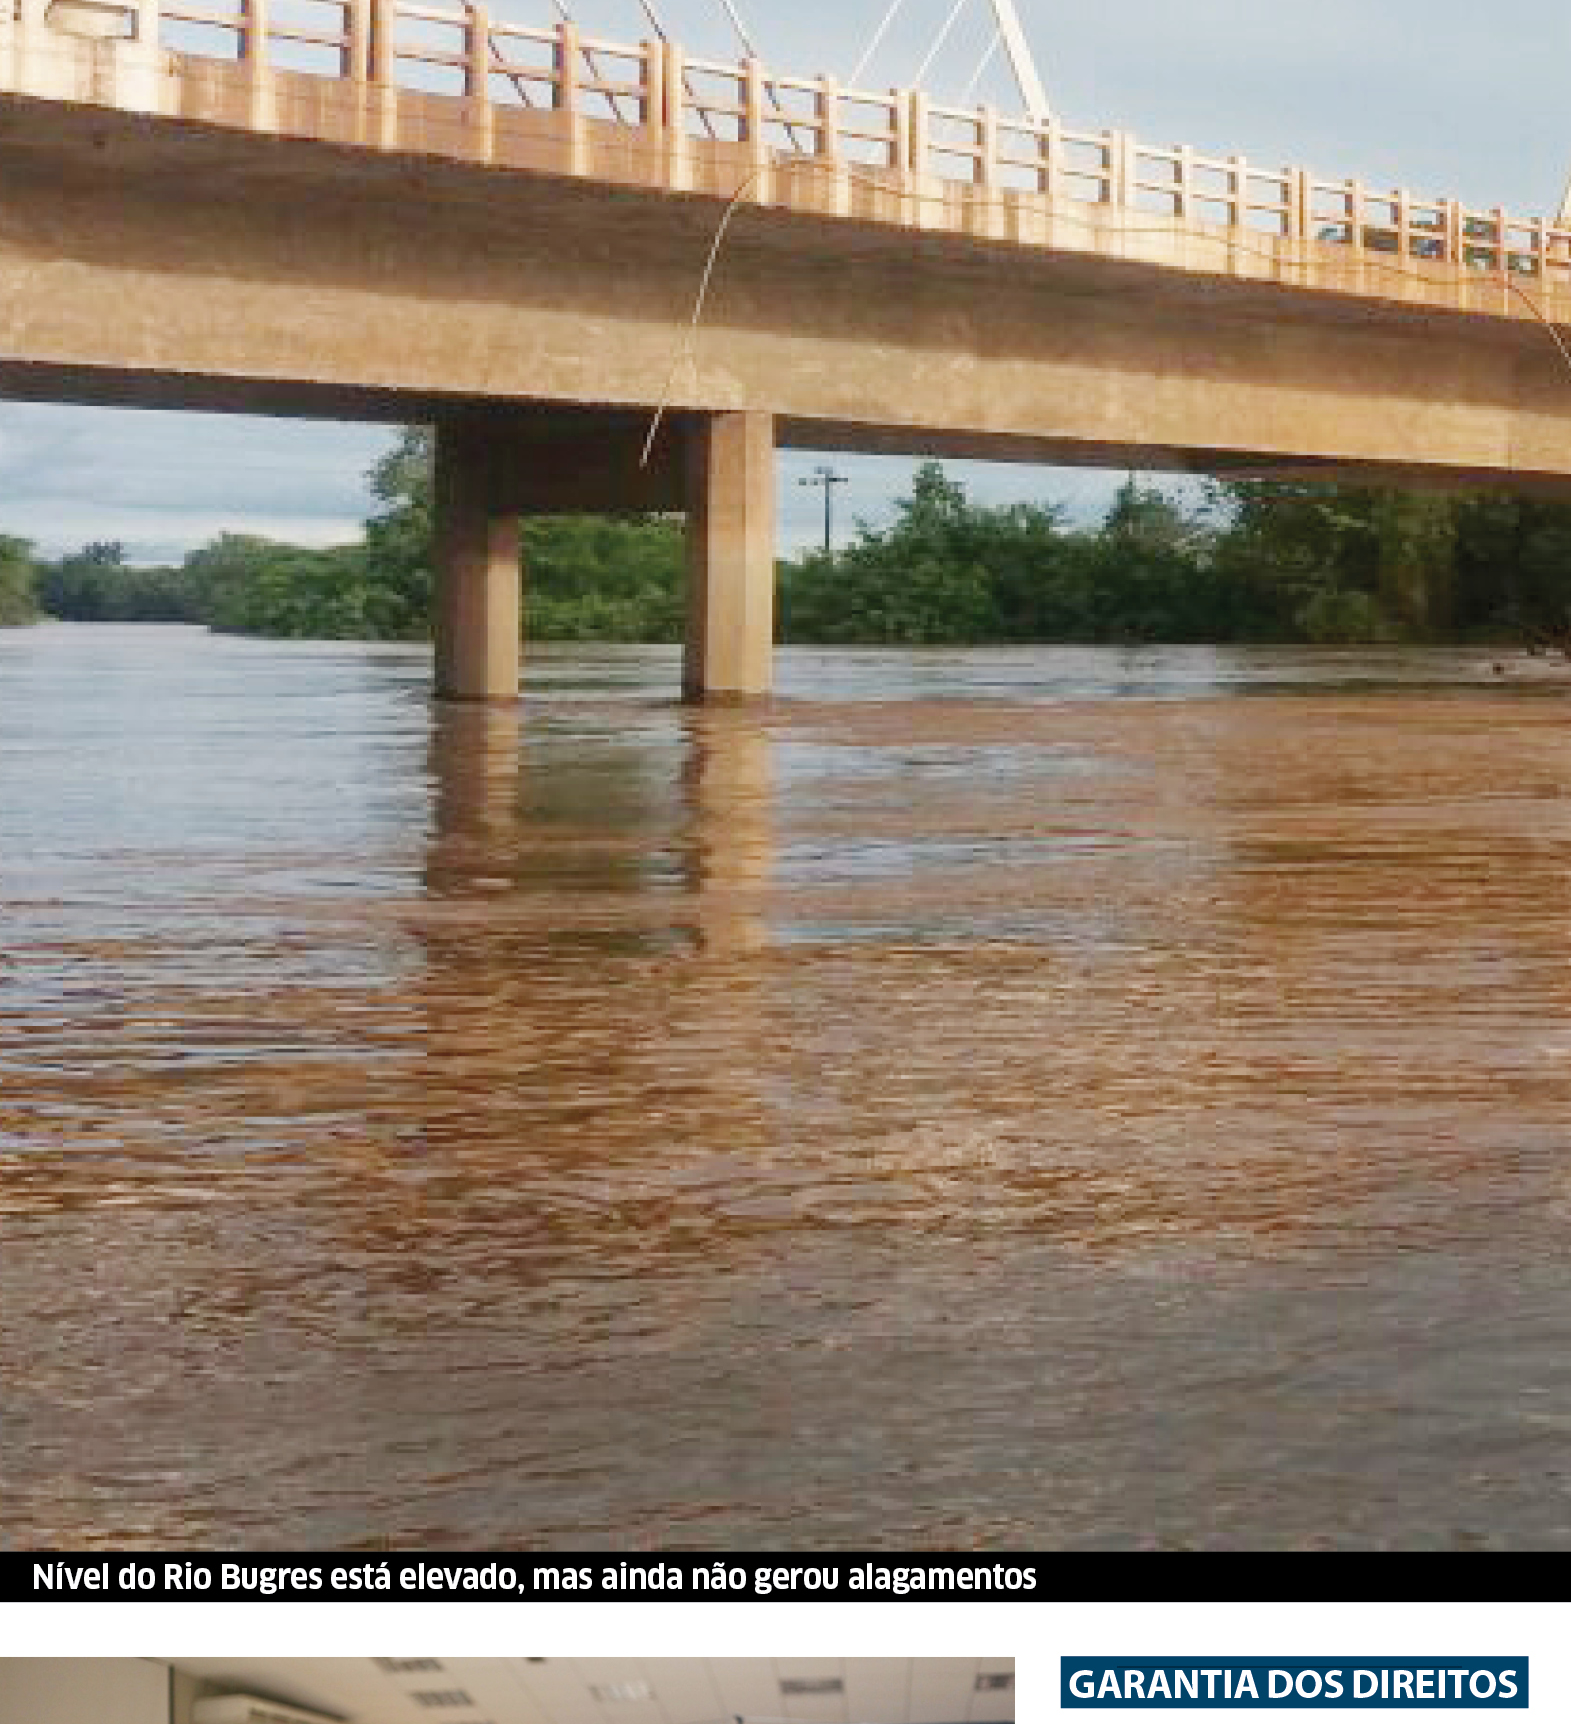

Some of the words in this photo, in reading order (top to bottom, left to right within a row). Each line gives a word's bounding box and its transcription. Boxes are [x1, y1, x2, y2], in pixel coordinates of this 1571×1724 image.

[33, 1561, 109, 1590] Nível
[118, 1562, 156, 1590] do
[164, 1561, 212, 1590] Rio
[221, 1563, 323, 1595] Bugres
[330, 1561, 391, 1590] está
[399, 1562, 525, 1595] elevado,
[533, 1567, 593, 1590] mas
[601, 1561, 683, 1590] ainda
[692, 1561, 747, 1590] não
[754, 1567, 839, 1595] gerou
[848, 1562, 1037, 1595] alagamentos
[1068, 1669, 1260, 1699] GARANTIA
[1268, 1669, 1344, 1699] DOS
[1353, 1669, 1518, 1699] DIREITOS
